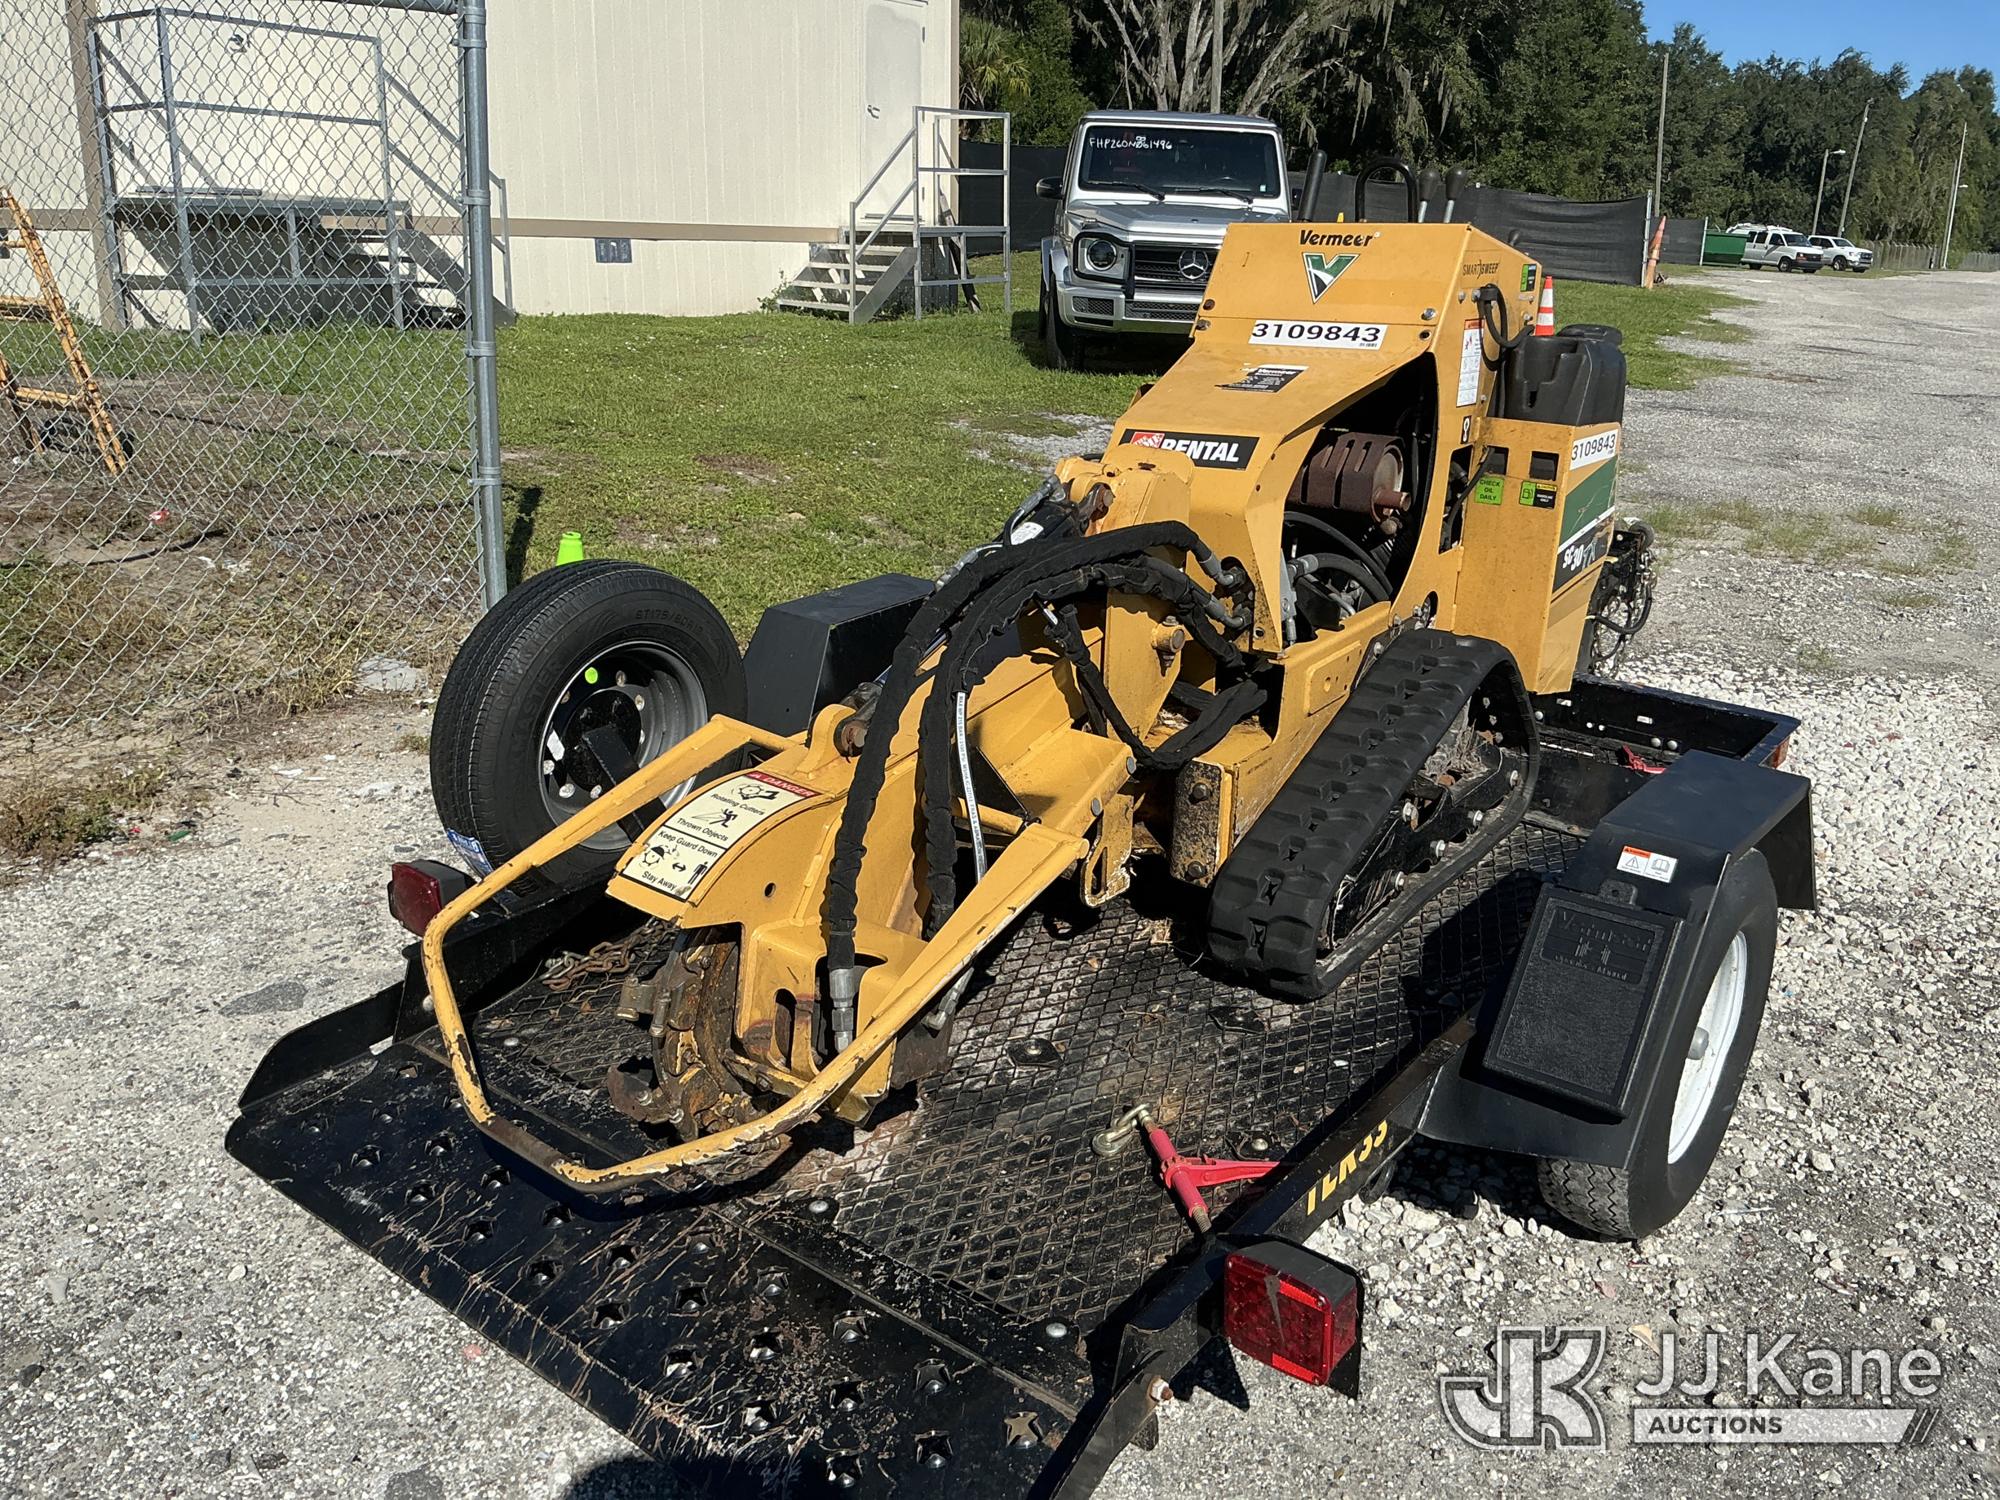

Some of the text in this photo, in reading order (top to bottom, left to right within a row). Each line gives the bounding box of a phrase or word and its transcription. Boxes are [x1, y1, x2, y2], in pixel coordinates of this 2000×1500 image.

[1300, 229, 1373, 247] Vermeer
[1252, 322, 1381, 342] 3109843
[1571, 433, 1616, 461] 3109843
[764, 774, 813, 798] DANGER
[710, 793, 765, 815] Rotating Cutters
[677, 817, 728, 842] Thrown Objects
[658, 830, 718, 858] Keep Guard Down
[641, 871, 677, 890] Stay Away
